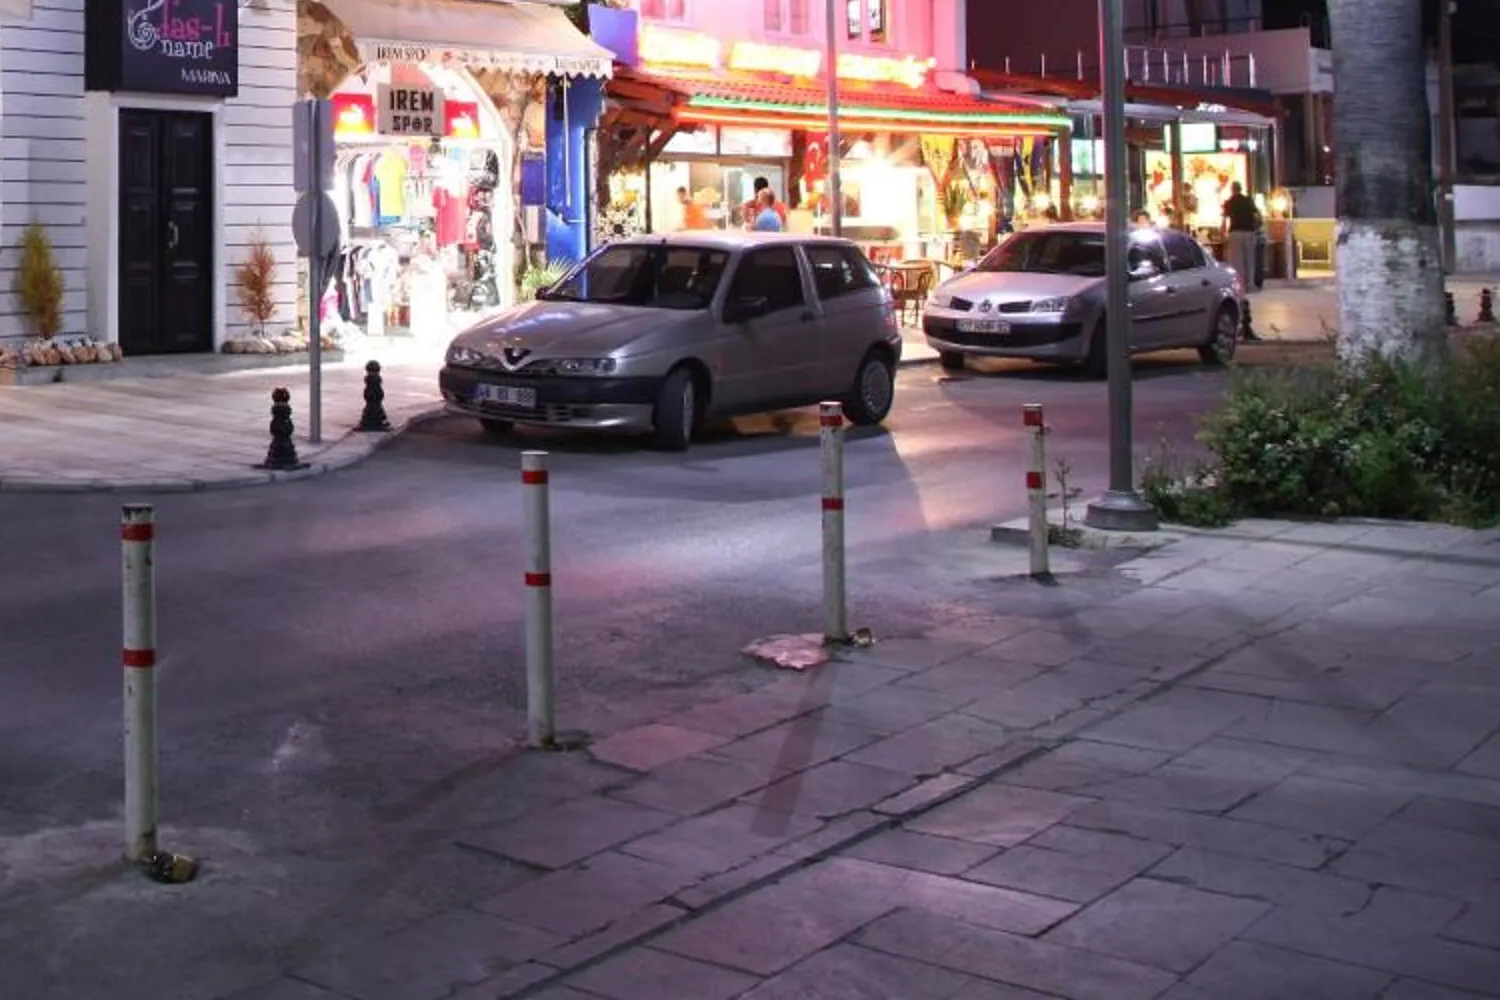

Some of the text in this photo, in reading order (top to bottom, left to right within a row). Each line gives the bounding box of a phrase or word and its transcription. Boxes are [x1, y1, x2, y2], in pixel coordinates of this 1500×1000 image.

[161, 40, 213, 60] name
[390, 89, 434, 112] IREM
[392, 115, 433, 133] SPOR
